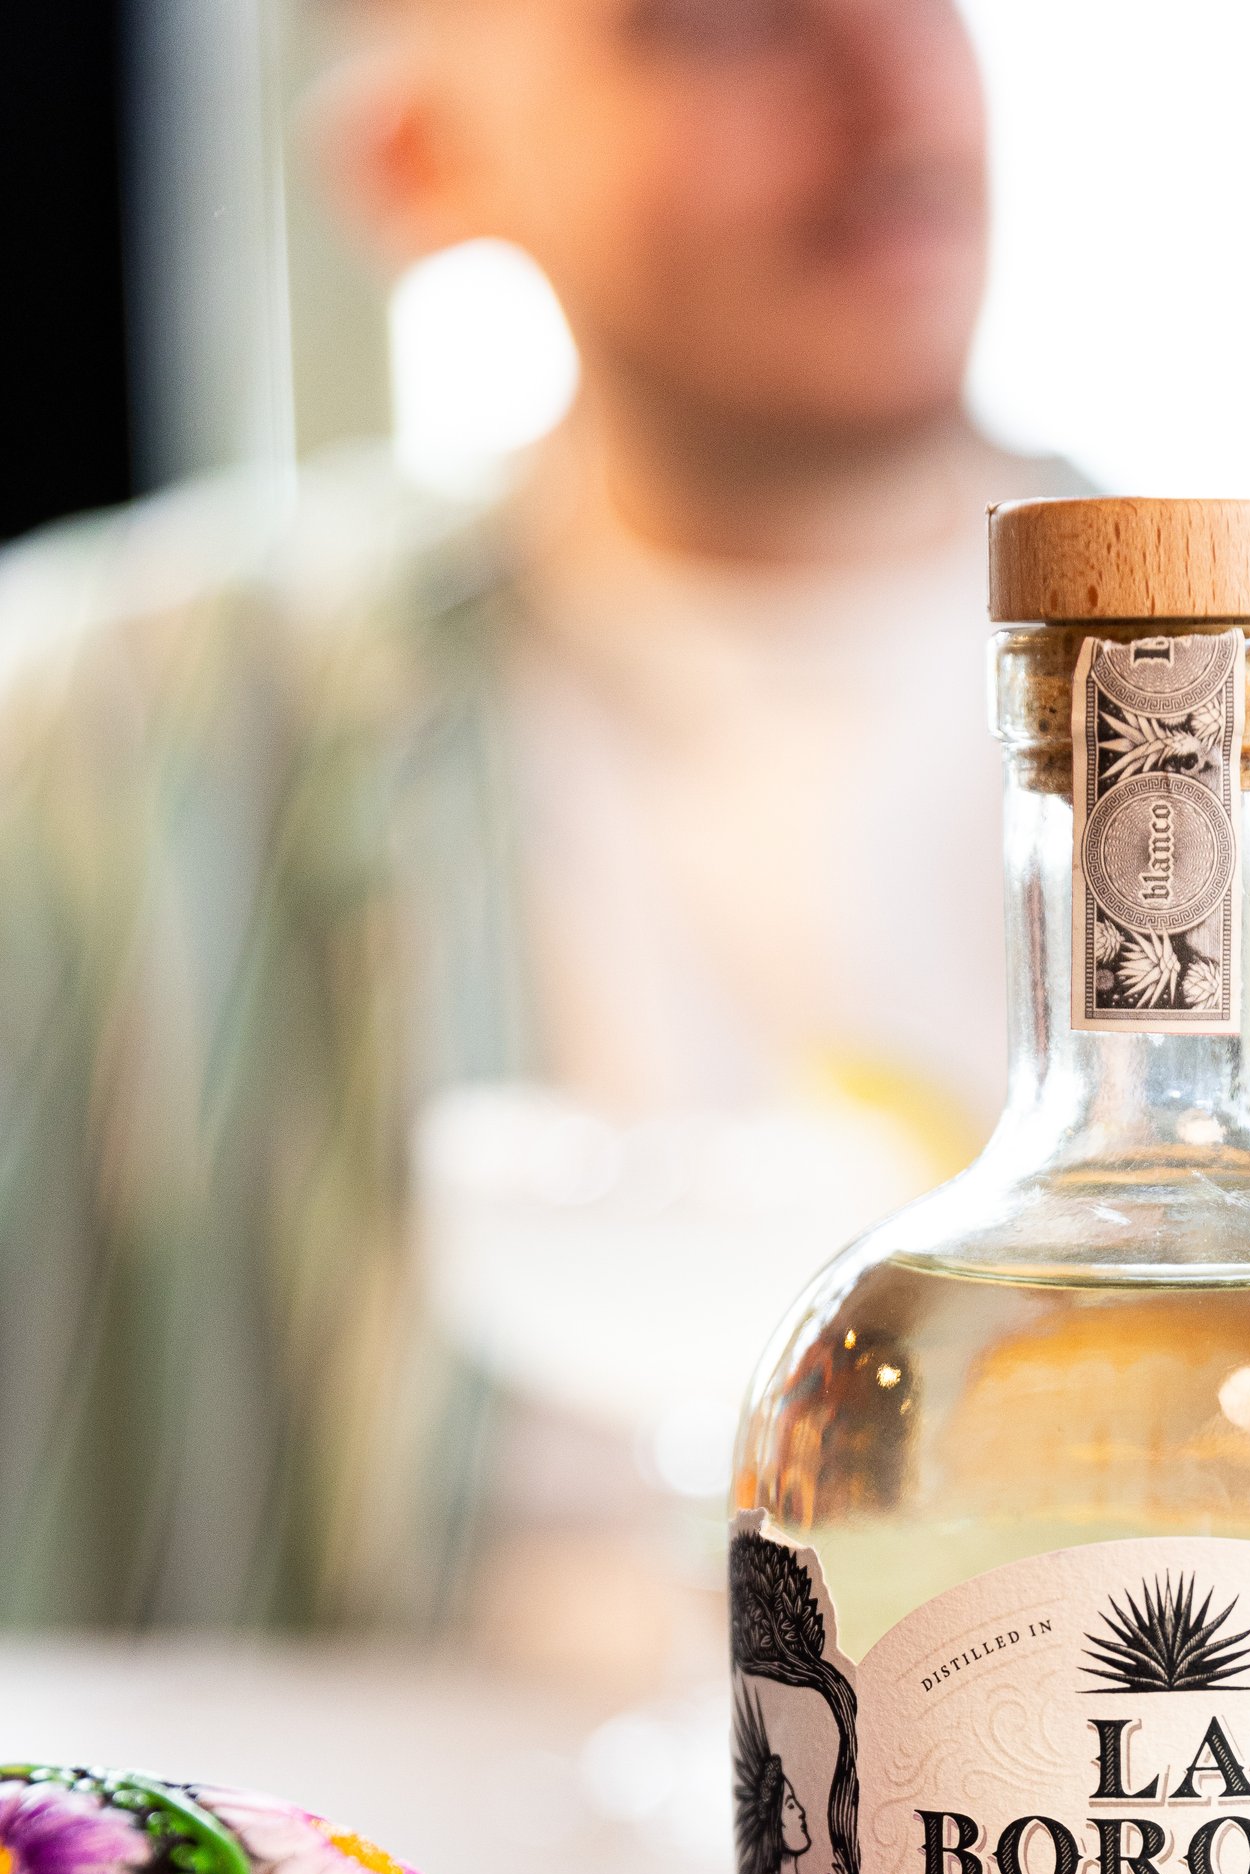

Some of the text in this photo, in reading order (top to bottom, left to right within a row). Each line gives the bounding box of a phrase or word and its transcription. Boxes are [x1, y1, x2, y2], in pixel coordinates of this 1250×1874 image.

[1142, 804, 1171, 900] blanco
[921, 1619, 1053, 1692] DISTILLED IN
